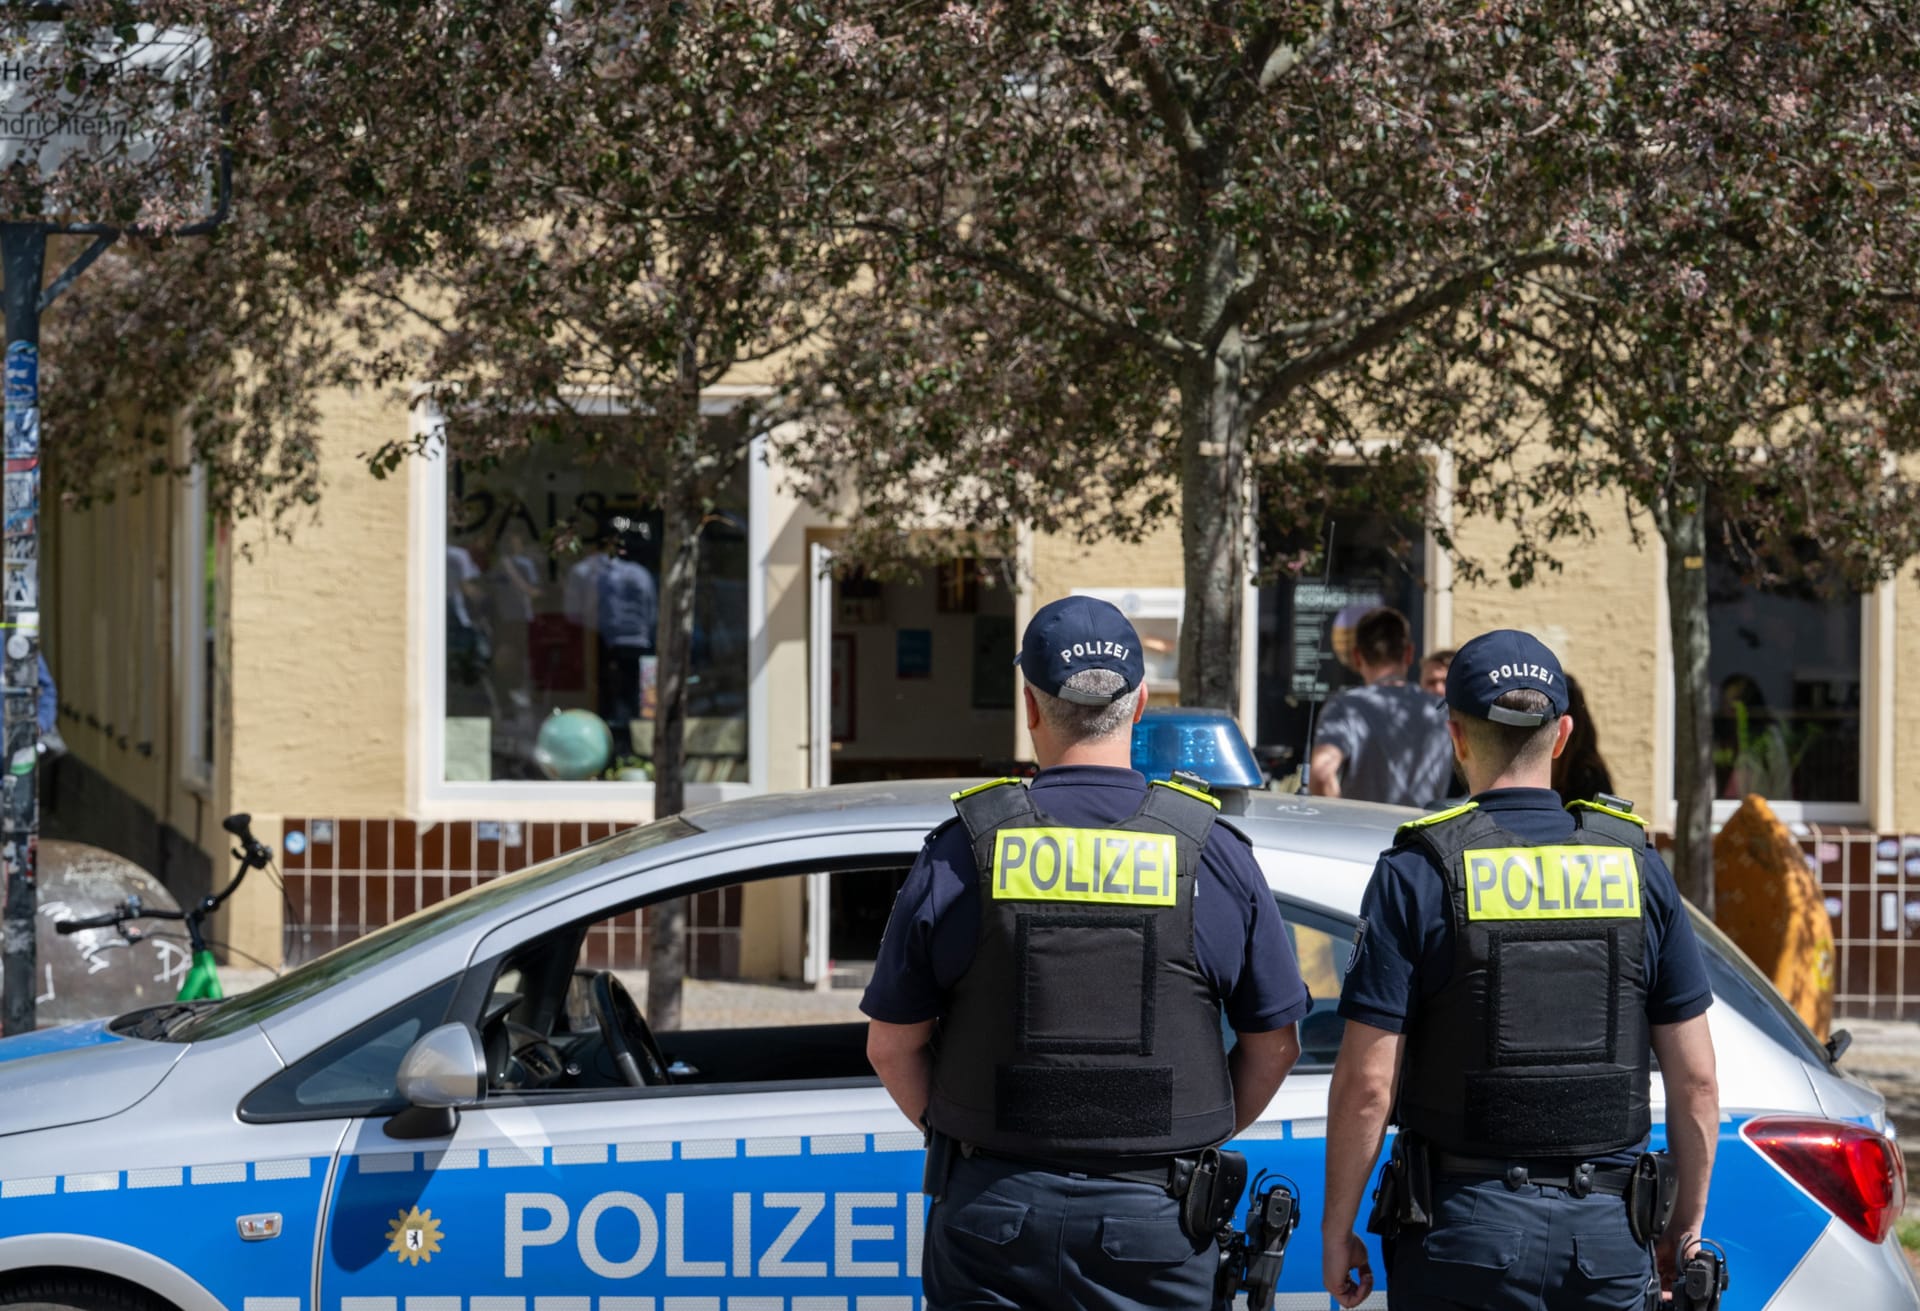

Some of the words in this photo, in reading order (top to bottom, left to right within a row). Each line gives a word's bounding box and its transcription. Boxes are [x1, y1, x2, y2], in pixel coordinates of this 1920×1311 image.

[1061, 641, 1128, 663] POLIZEI
[1489, 663, 1553, 685] POLIZEI
[999, 836, 1169, 896] POLIZEI
[1471, 854, 1634, 912] POLIZEI
[505, 1191, 924, 1278] POLIZEI
